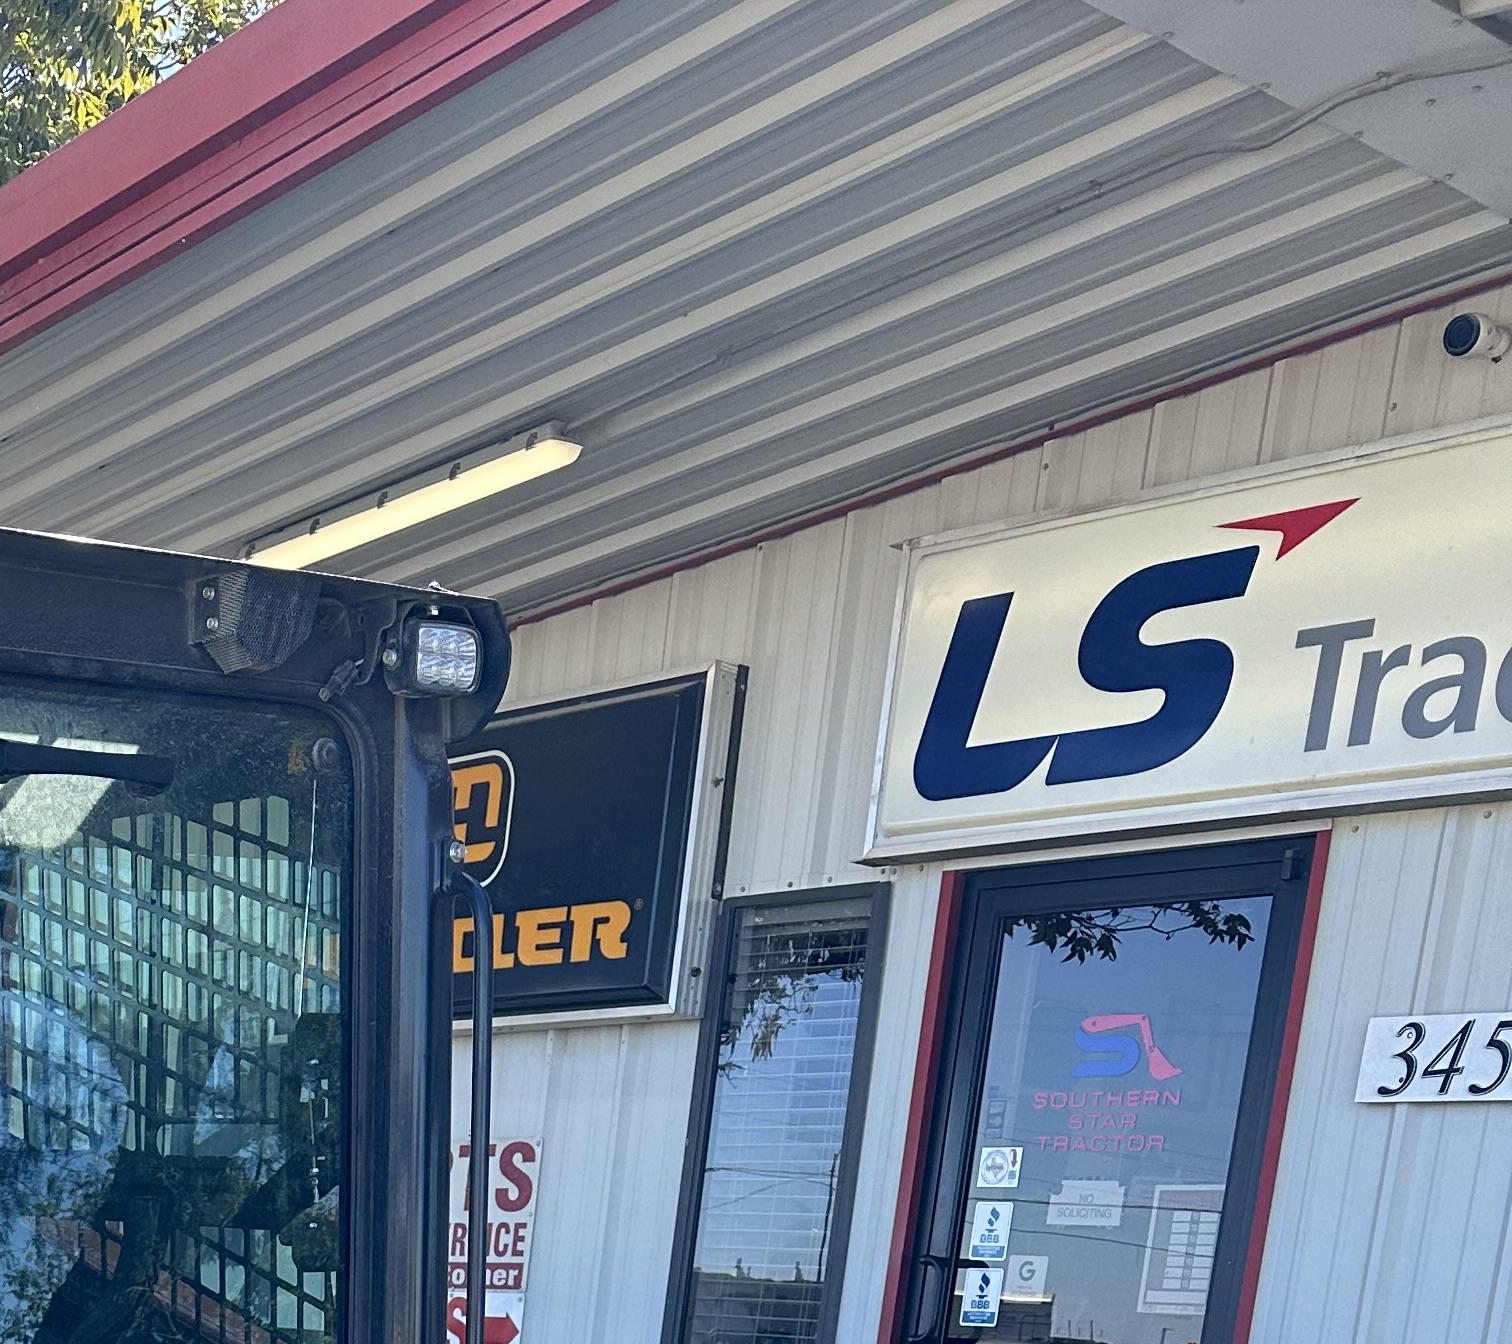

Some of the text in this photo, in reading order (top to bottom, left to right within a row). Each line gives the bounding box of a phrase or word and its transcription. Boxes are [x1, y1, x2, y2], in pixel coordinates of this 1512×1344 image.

[913, 545, 1512, 801] LS Tra
[1377, 1019, 1512, 1098] 345
[1032, 1089, 1182, 1111] SOUTHERN
[1068, 1112, 1138, 1130] STAR
[1037, 1134, 1166, 1154] TRACTOR
[1078, 1193, 1095, 1204] NO
[1056, 1207, 1113, 1219] SOLICITING
